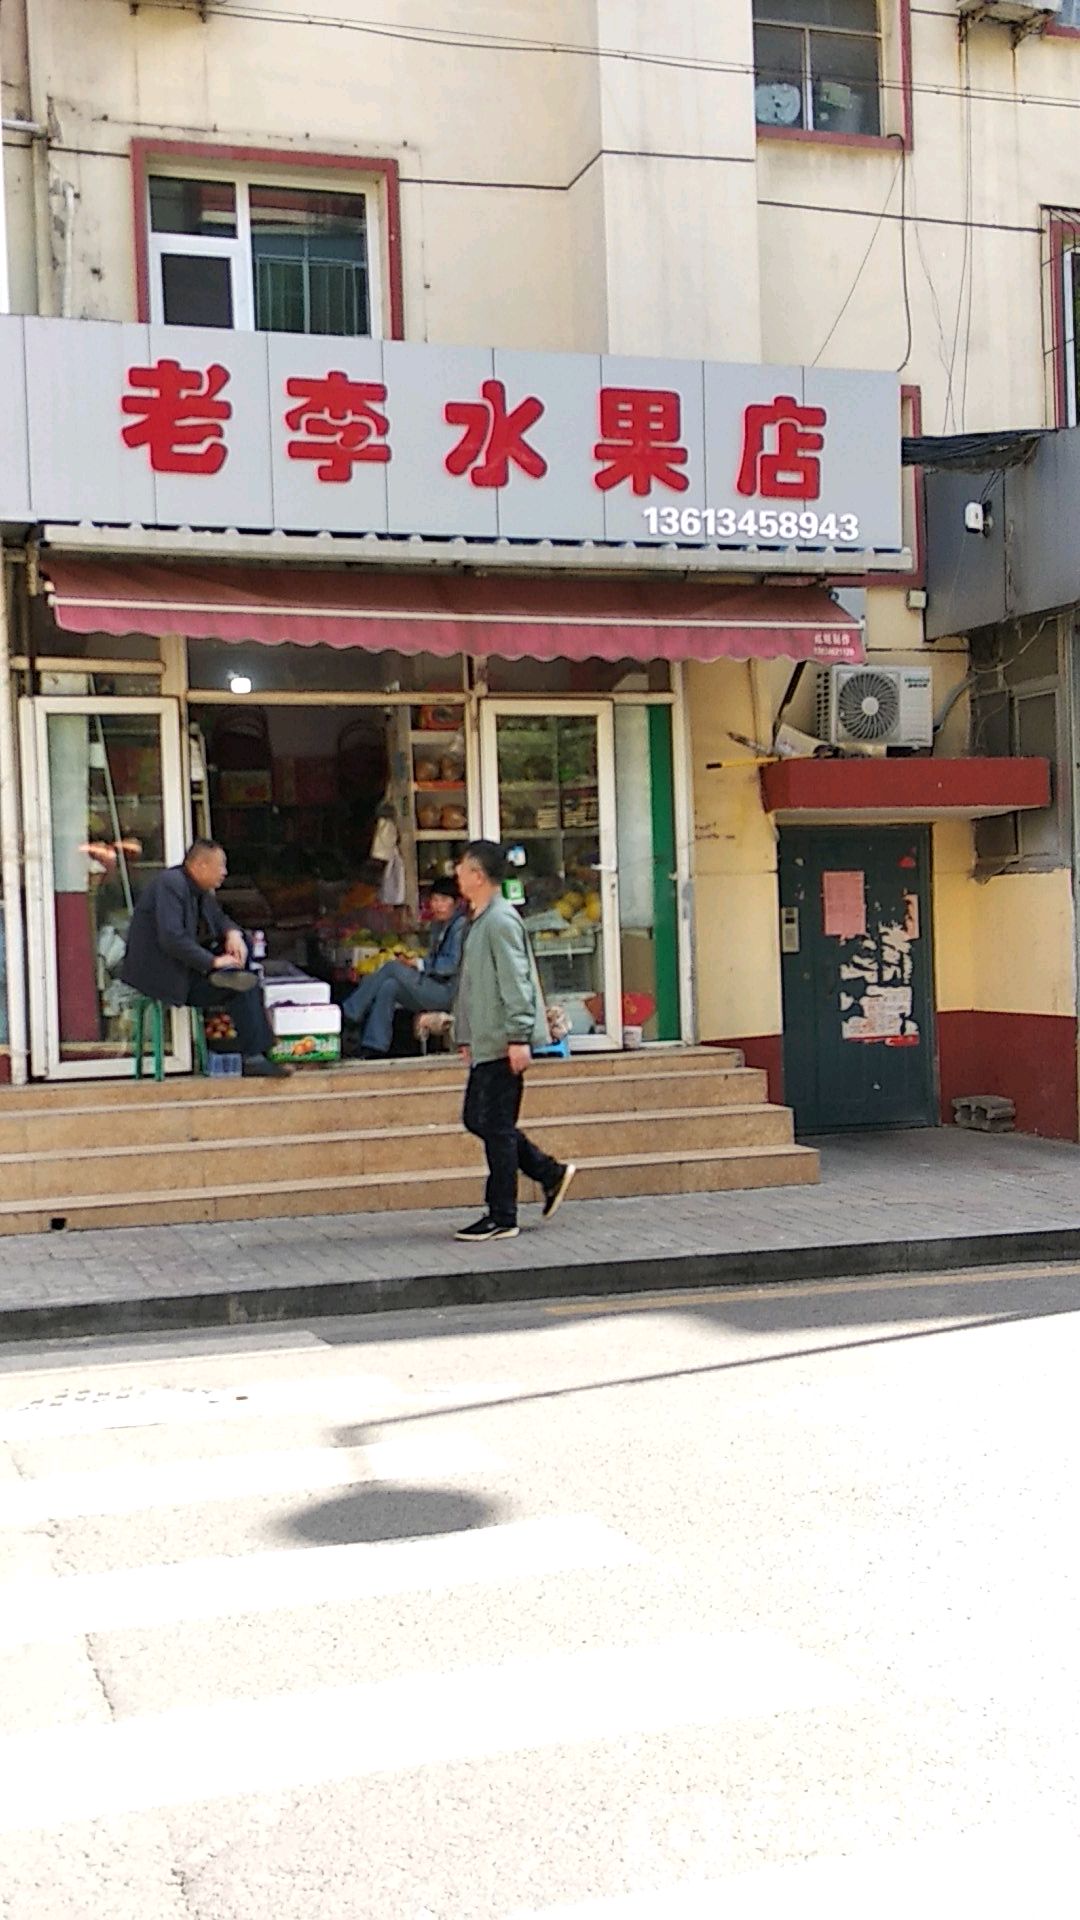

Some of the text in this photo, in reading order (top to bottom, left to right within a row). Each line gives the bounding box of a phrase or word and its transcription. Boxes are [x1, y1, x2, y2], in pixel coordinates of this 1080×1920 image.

[120, 359, 826, 500] 老李水果店
[643, 506, 859, 541] 13613458943
